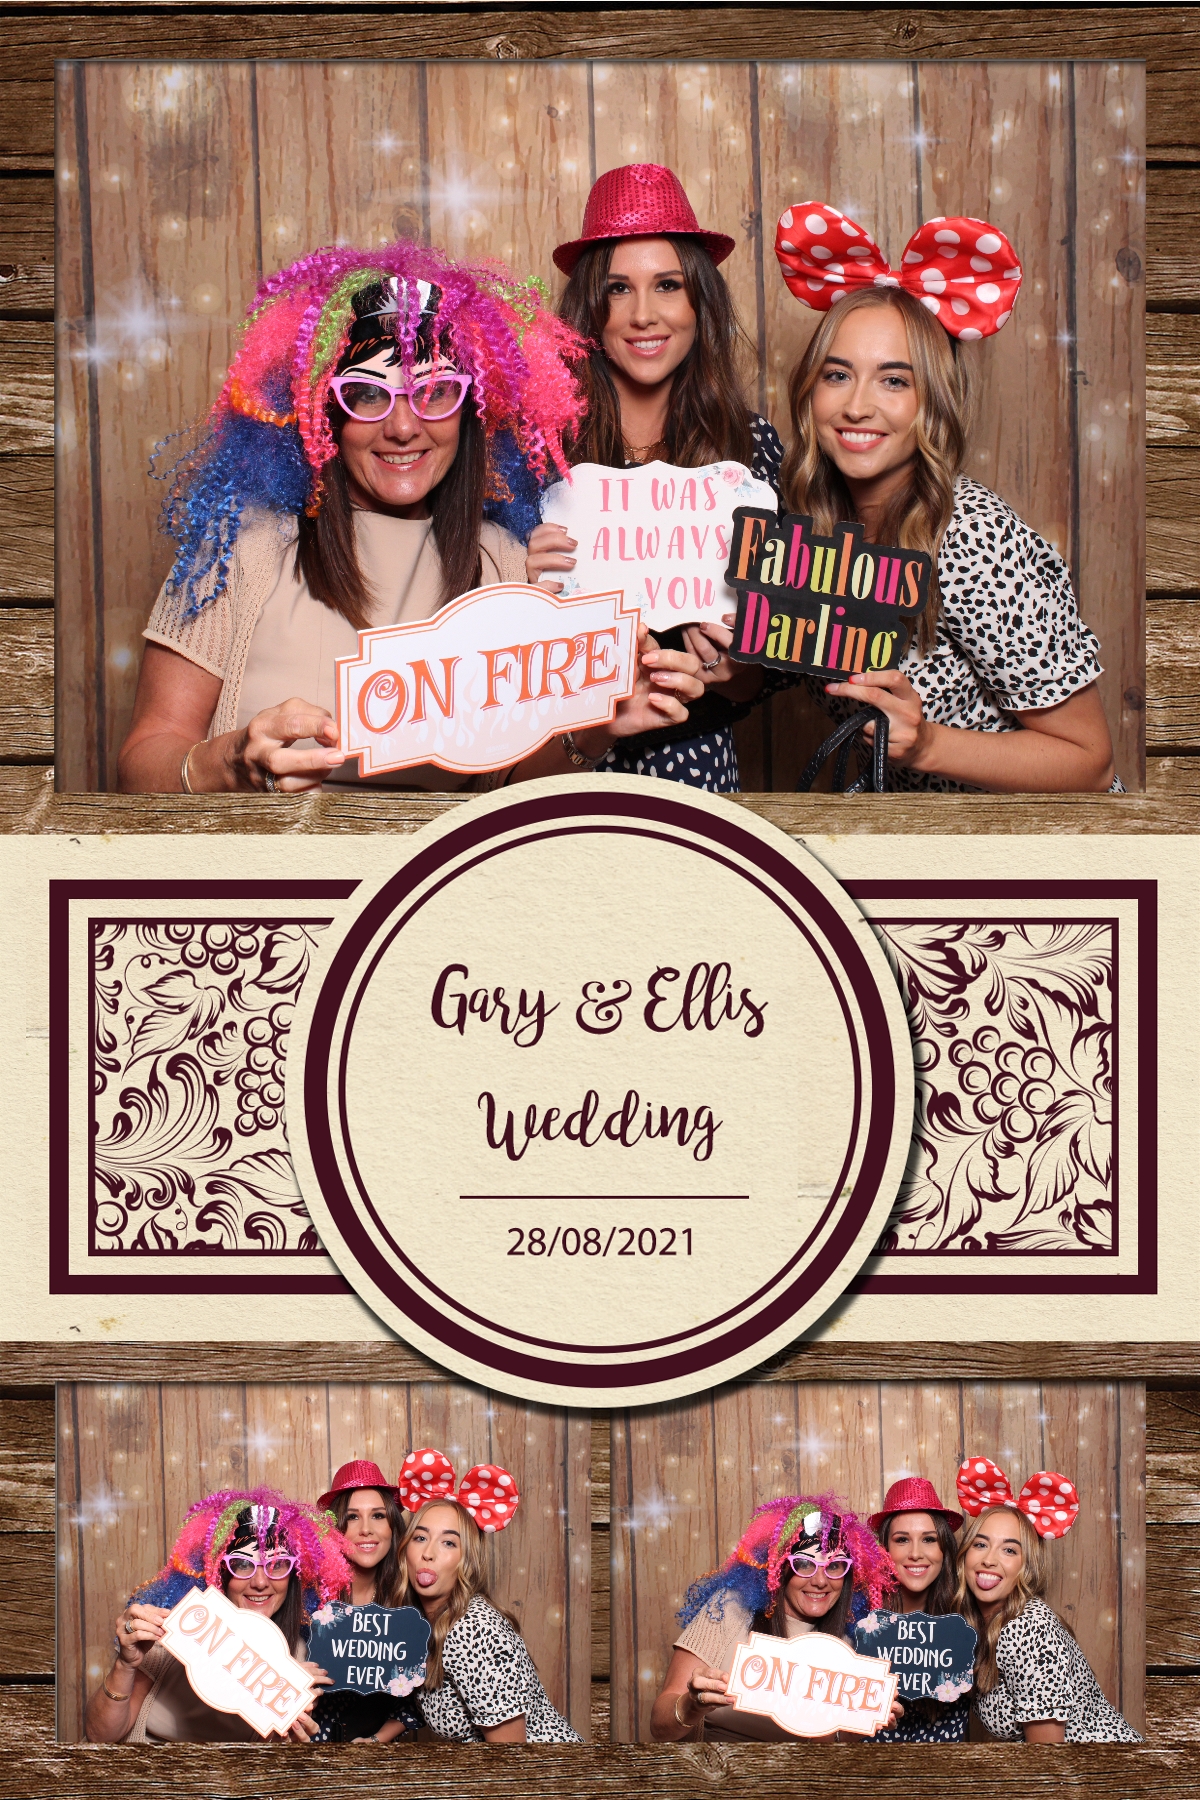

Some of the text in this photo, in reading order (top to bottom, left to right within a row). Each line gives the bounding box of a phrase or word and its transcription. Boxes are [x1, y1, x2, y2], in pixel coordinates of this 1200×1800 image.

[599, 476, 718, 513] IT WAS
[592, 523, 730, 562] ALWAYS
[734, 515, 923, 608] Fabulous
[644, 576, 716, 610] YOU
[737, 590, 898, 673] Darling
[357, 626, 620, 735] ON FIRE
[352, 1611, 391, 1637] BEST
[897, 1619, 937, 1644] BEST
[177, 1603, 302, 1719] ON FIRE
[331, 1638, 408, 1662] WEDDING
[876, 1645, 953, 1669] WEDDING
[345, 1664, 387, 1690] EVER
[740, 1654, 885, 1713] ON FIRE
